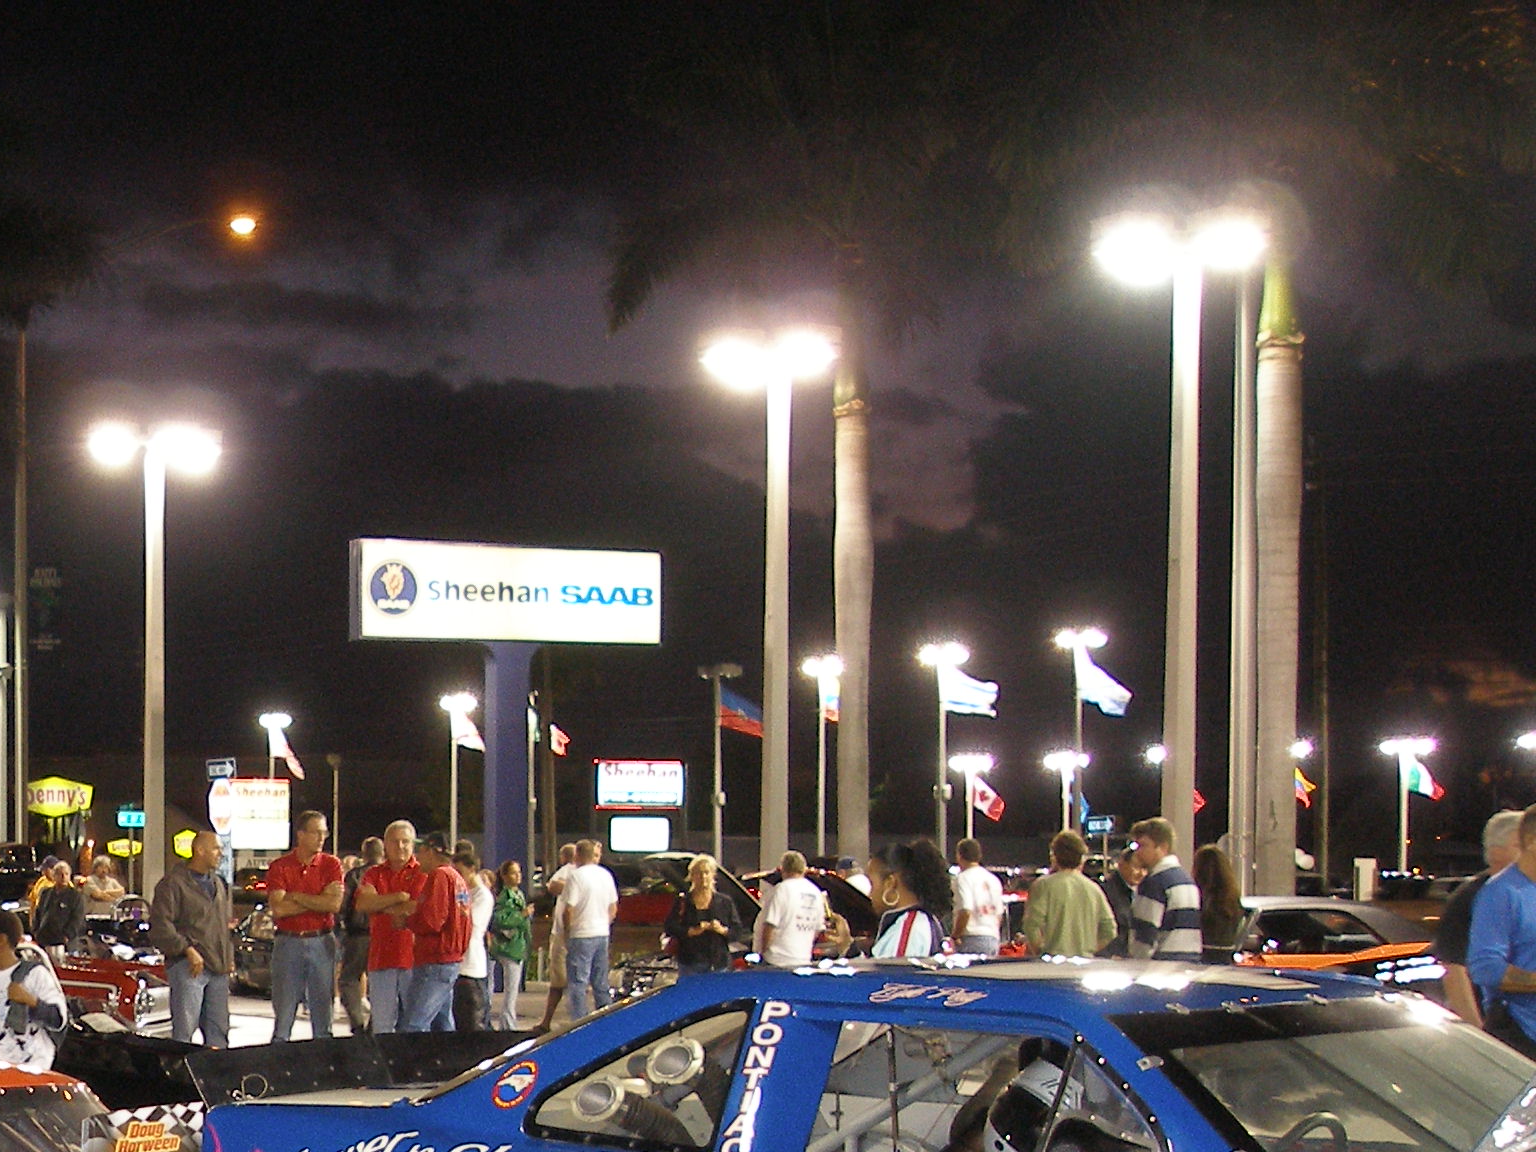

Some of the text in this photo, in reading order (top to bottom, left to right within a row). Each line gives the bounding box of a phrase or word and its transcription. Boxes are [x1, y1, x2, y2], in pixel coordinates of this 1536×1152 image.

[428, 580, 654, 606] Sheehan SAAB
[129, 1122, 165, 1139] Doug
